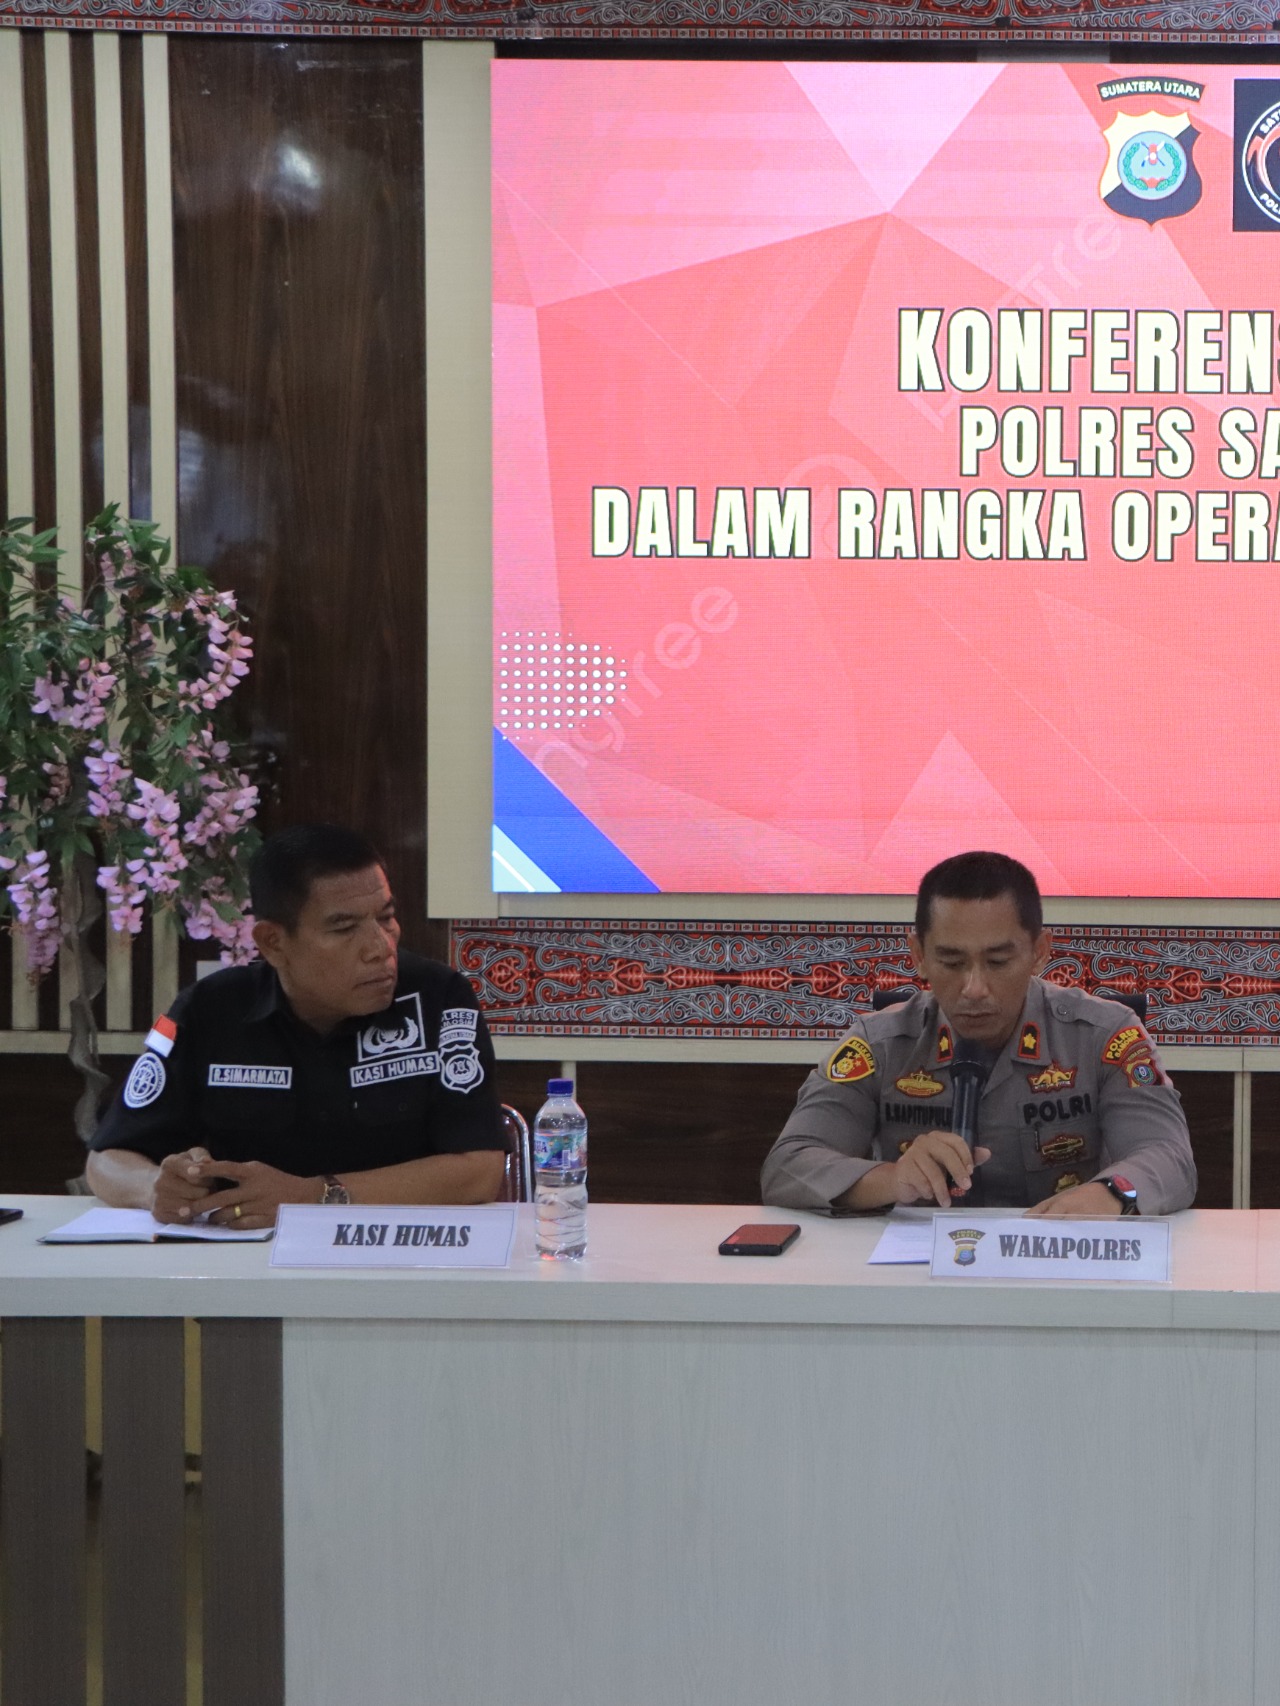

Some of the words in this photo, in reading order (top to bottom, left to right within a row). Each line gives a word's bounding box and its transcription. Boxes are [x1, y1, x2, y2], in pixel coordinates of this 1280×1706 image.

[1101, 81, 1161, 98] SUMATERA
[1164, 82, 1200, 99] UTARA
[960, 405, 1195, 479] POLRES
[591, 485, 812, 559] DALAM
[837, 487, 1088, 562] RANGKA
[1106, 1028, 1140, 1060] POLRES
[213, 1067, 287, 1086] R.SIMARMATA
[354, 1066, 385, 1084] KASI
[388, 1056, 435, 1076] HUMAS
[1023, 1093, 1092, 1125] POLRI
[332, 1224, 389, 1246] KASI
[392, 1224, 471, 1248] HUMAS
[998, 1234, 1142, 1262] WAKAPOLRES
